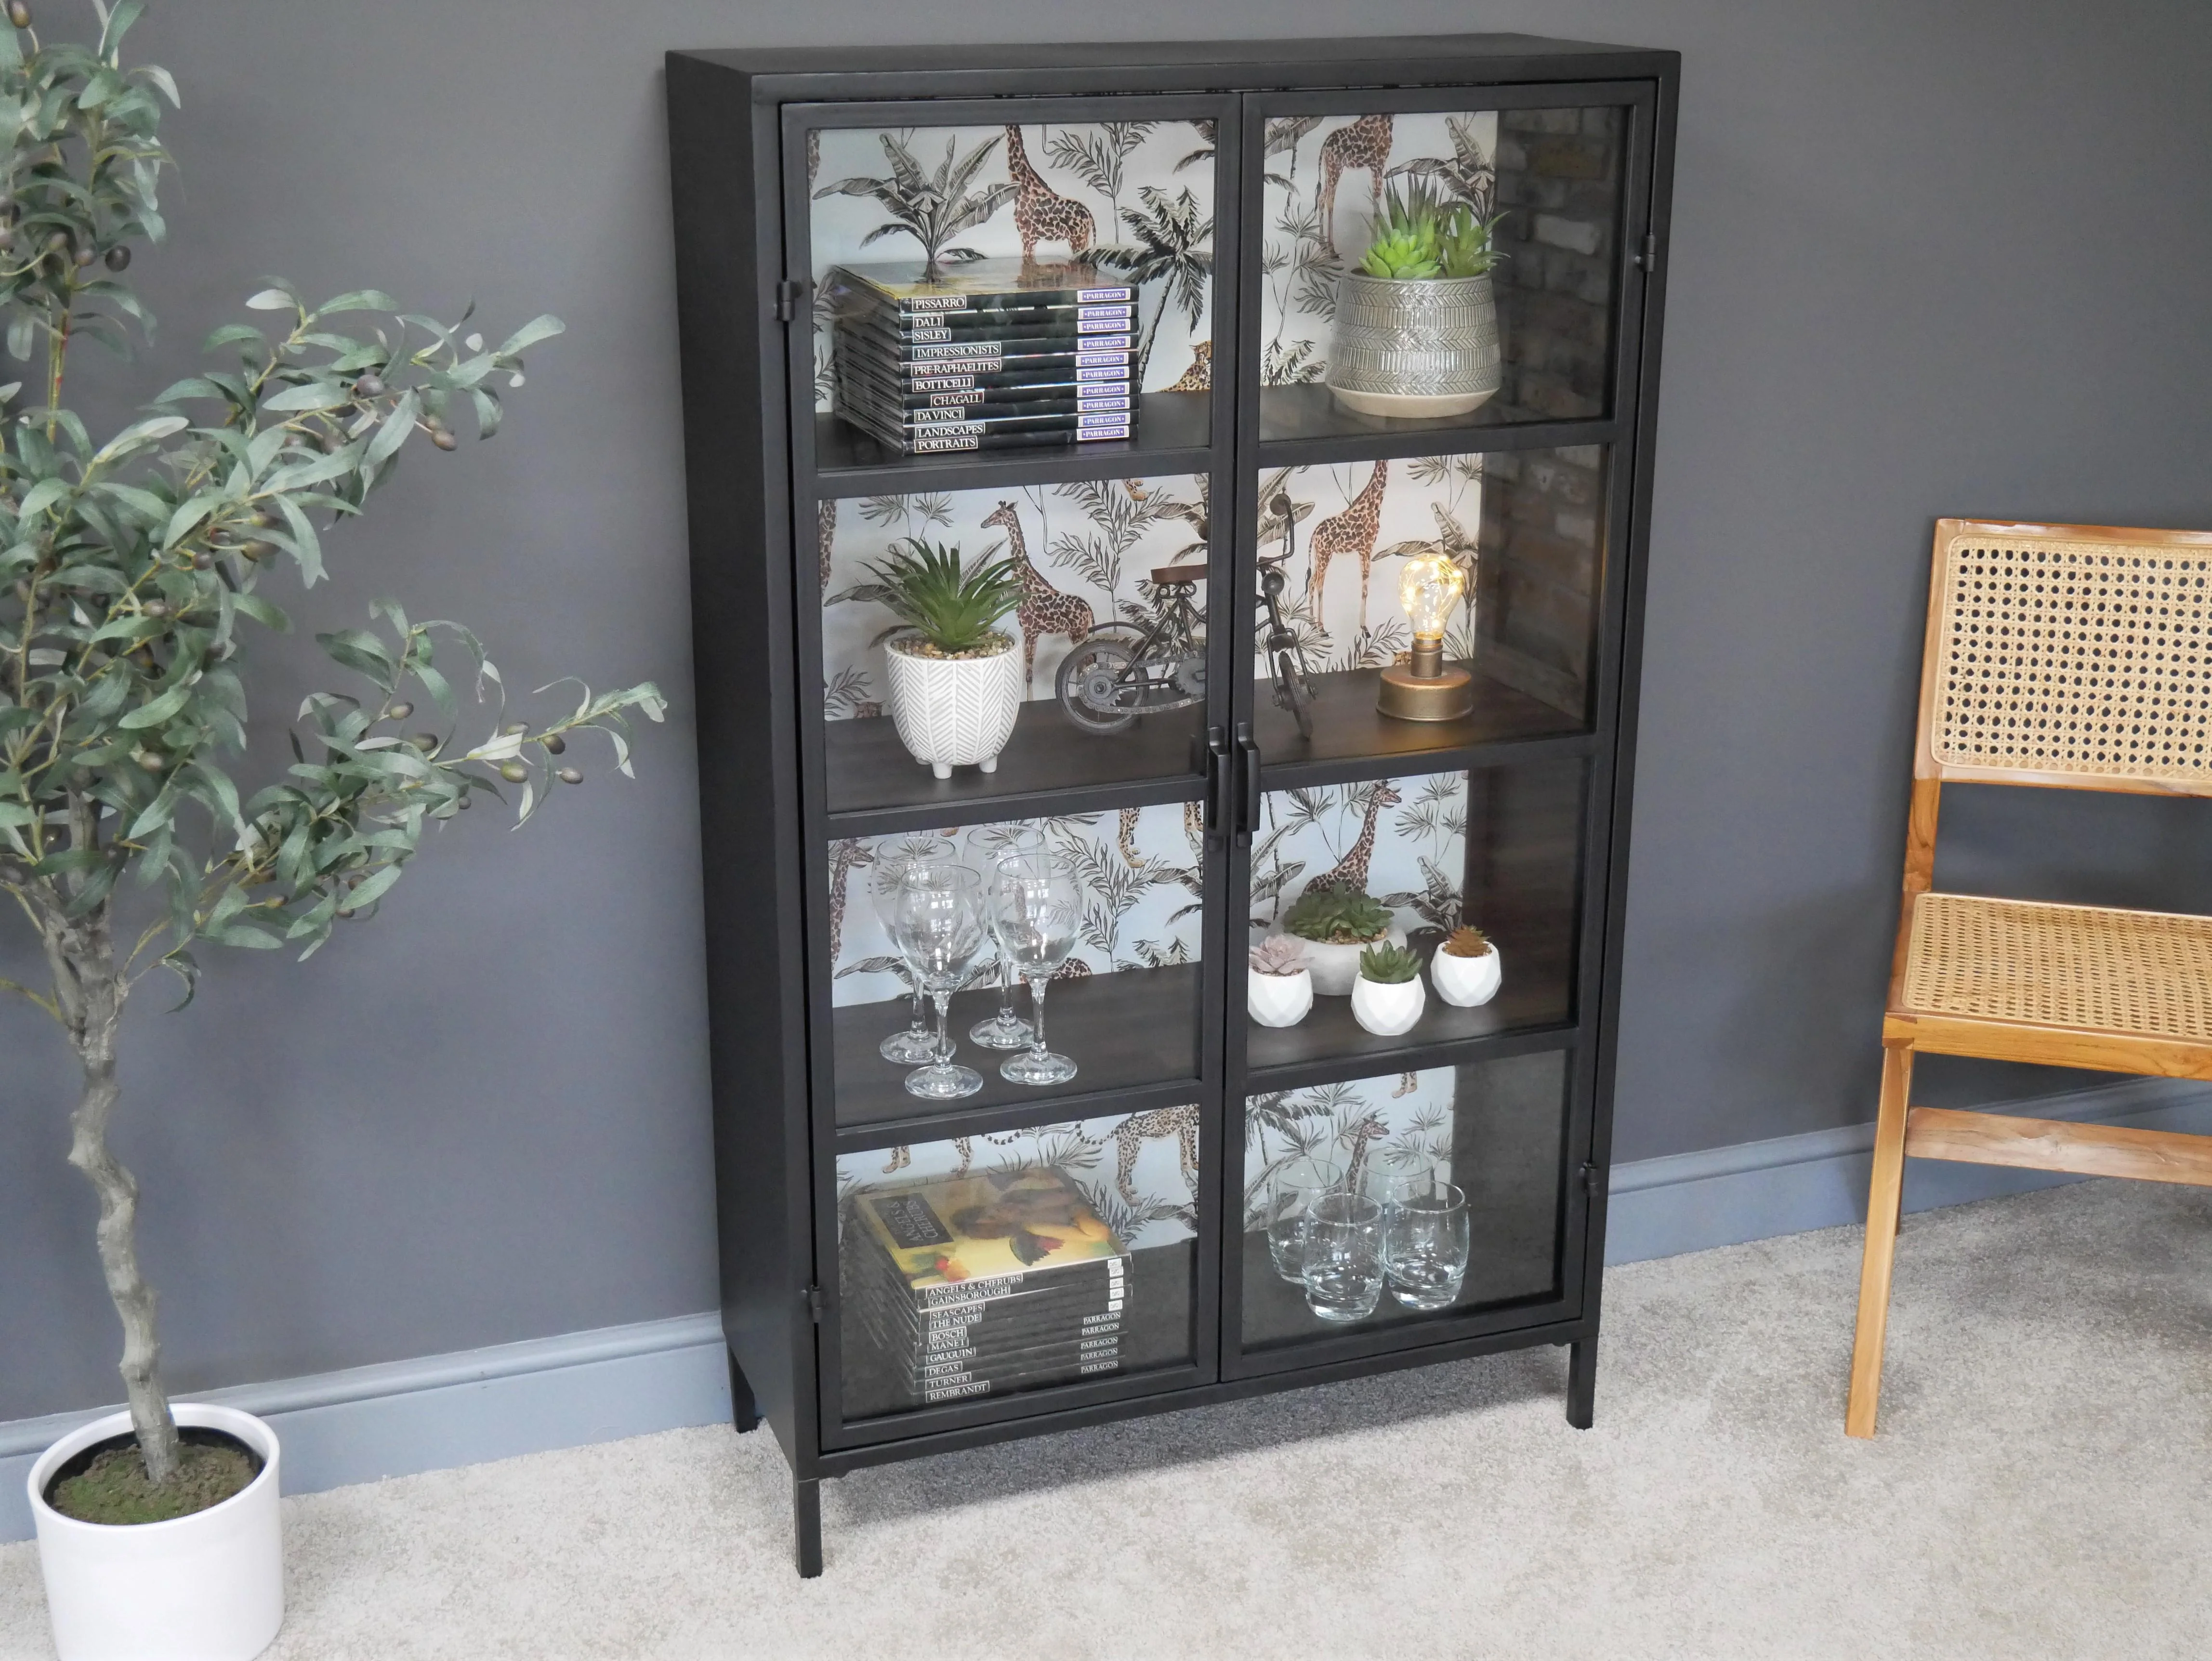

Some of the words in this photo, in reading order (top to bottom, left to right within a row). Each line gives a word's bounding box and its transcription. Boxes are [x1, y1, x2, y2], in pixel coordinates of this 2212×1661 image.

[915, 298, 964, 309] PISSARRO
[916, 317, 941, 327] DALI
[915, 330, 948, 340] SISLEY
[917, 345, 999, 357] IMPRESSIONISTS
[914, 362, 999, 374] PRE-RAPHAELITES
[915, 378, 971, 390] BOTTICELLI
[1086, 386, 1121, 394] PARRAGON
[934, 395, 981, 406] CHAGALL
[917, 411, 931, 420] DA
[933, 409, 961, 420] VINCI
[1087, 416, 1121, 424] PARRAGON
[918, 424, 983, 437] LANDSCAPES
[918, 437, 975, 449] PORTRAITS
[930, 1284, 965, 1296] ANGELS
[978, 1276, 1021, 1288] CHERUBS
[931, 1286, 1008, 1305] GAINSBOROUGH
[933, 1304, 983, 1319] SEASCAPES
[932, 1319, 951, 1329] THE
[954, 1314, 979, 1325] NUDE
[1083, 1312, 1120, 1324] PARRAGON
[1082, 1323, 1119, 1335] PARRAGON
[932, 1329, 963, 1342] BOSCH
[932, 1339, 965, 1351] MANET
[1081, 1337, 1118, 1349] PARRAGON
[930, 1348, 972, 1362] GAUGUIN
[1081, 1348, 1118, 1360] PARRAGON
[929, 1364, 959, 1375] DEGAS
[1081, 1361, 1118, 1373] PARRAGON
[929, 1375, 968, 1387] TURNER
[930, 1384, 987, 1400] REMBRANDT
